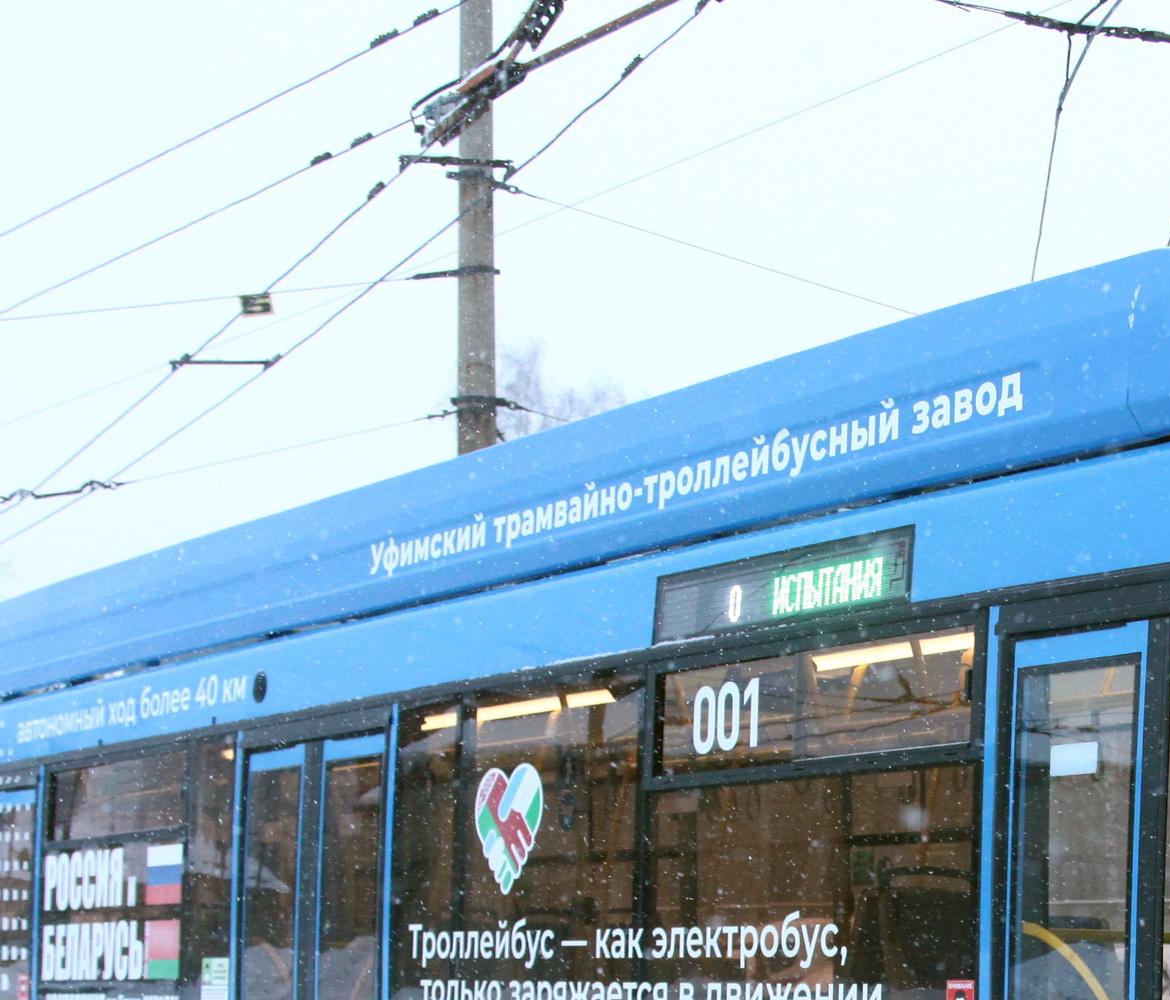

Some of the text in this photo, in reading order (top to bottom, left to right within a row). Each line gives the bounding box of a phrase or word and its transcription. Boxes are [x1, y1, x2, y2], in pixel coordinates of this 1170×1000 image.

[370, 372, 1024, 578] Уфимский трамвайно-троллейбусный завод
[771, 556, 884, 616] ИСПЫТАНИЯ
[16, 674, 248, 743] автономный ход более 40 км
[692, 677, 760, 755] 001
[43, 846, 124, 912] РОССИЯ
[41, 919, 144, 982] БЕЛАРУСЬ
[408, 918, 555, 969] Троллейбус
[595, 927, 645, 960] как
[651, 910, 848, 969] электробус,
